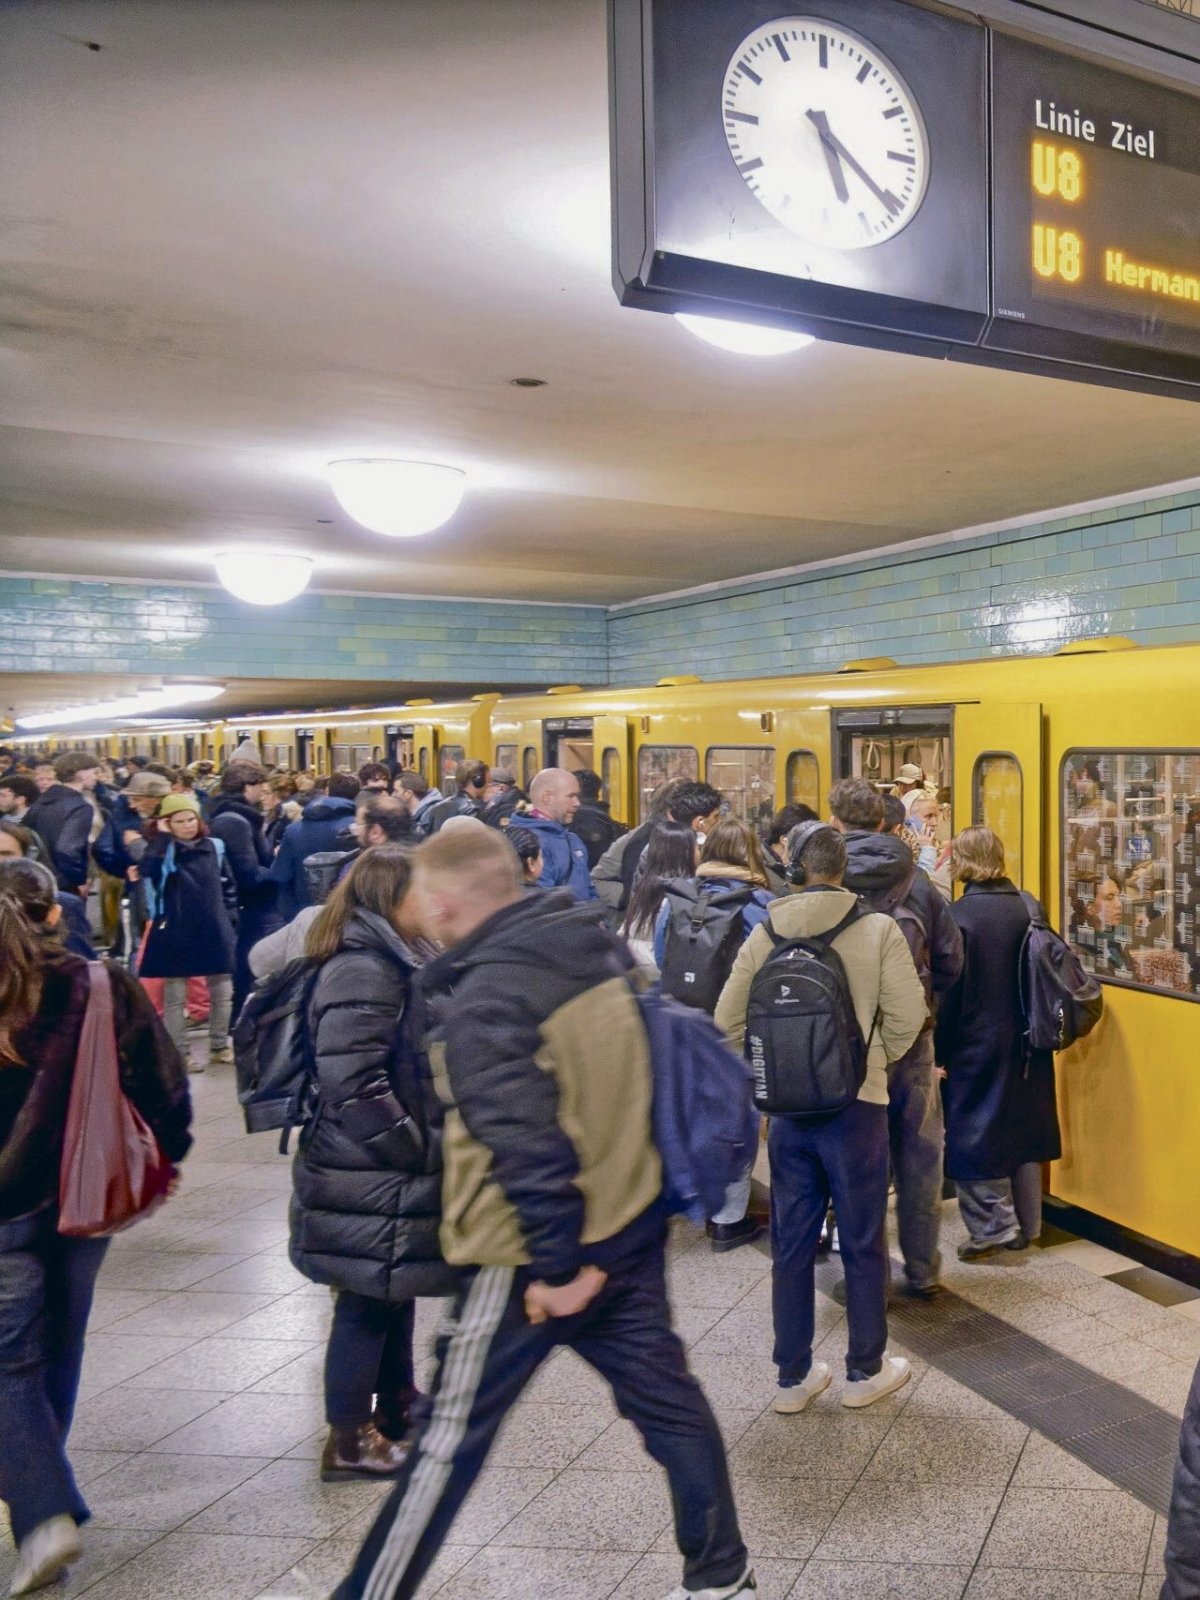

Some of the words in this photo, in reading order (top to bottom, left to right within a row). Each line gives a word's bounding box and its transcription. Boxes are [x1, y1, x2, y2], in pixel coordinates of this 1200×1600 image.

[1035, 99, 1096, 142] Linie
[1111, 120, 1155, 159] Ziel
[1032, 142, 1081, 201] U8
[1033, 224, 1081, 282] U8
[749, 1035, 768, 1100] #DIGITIAN
